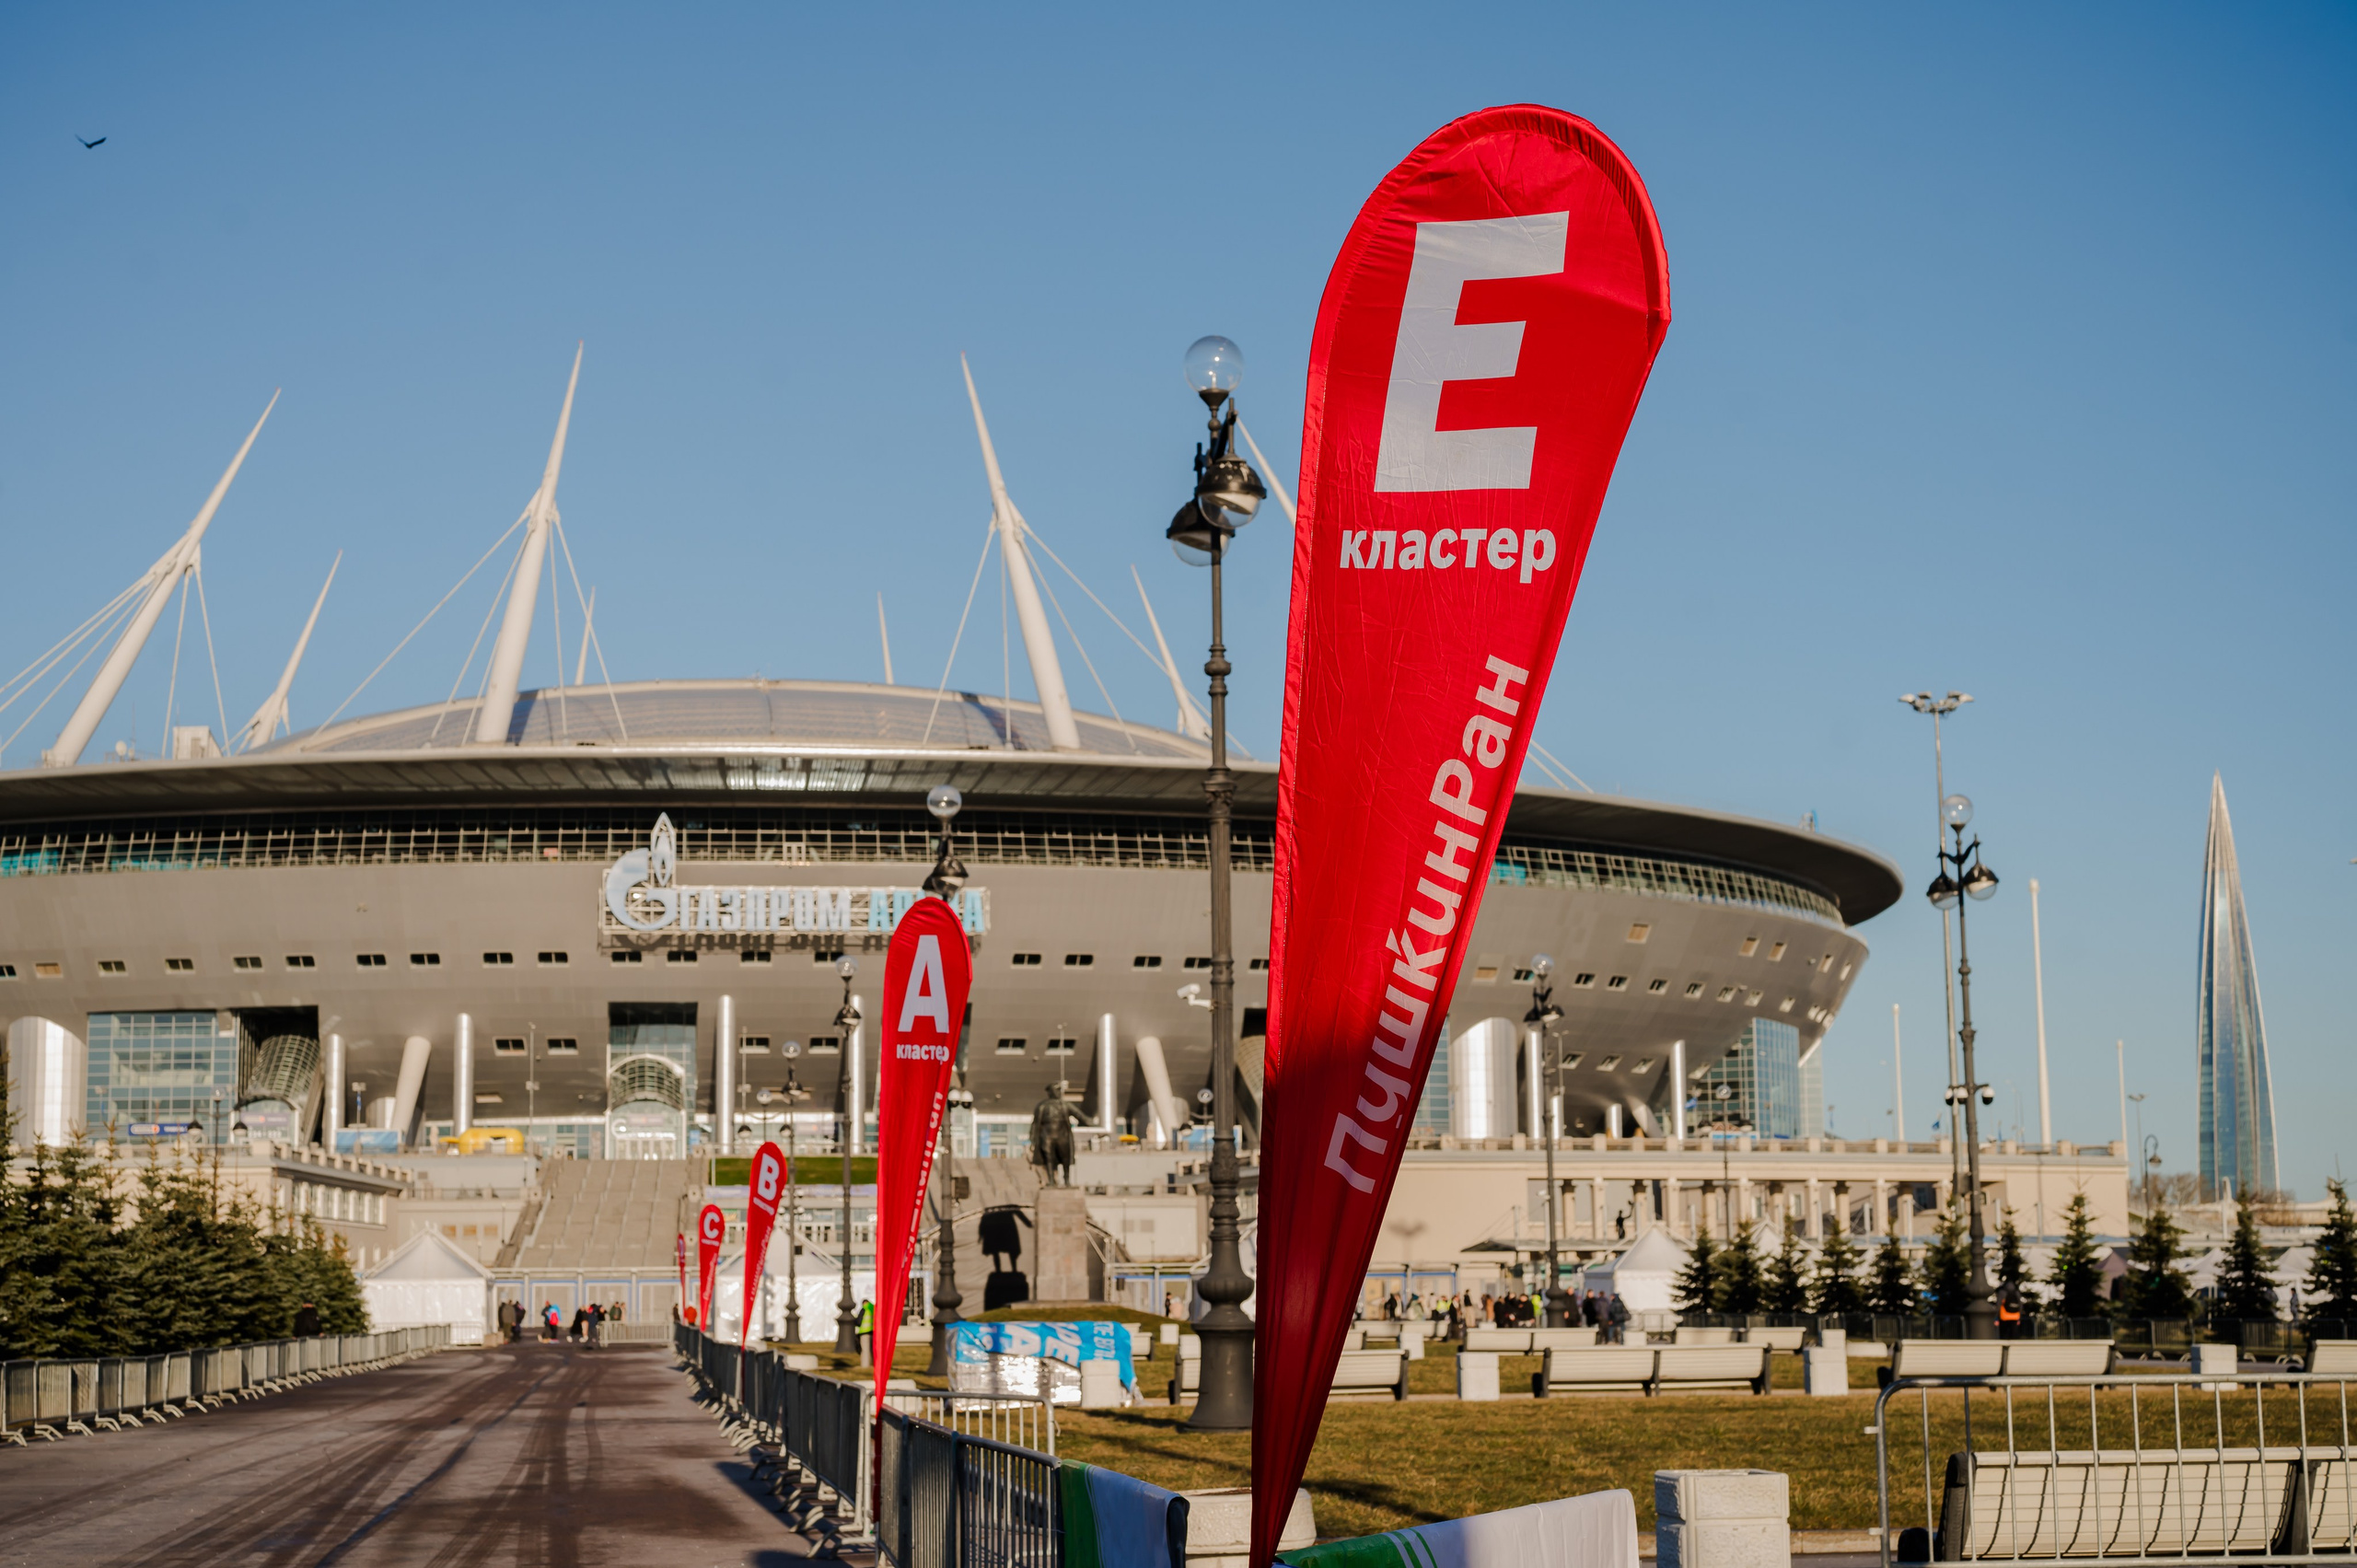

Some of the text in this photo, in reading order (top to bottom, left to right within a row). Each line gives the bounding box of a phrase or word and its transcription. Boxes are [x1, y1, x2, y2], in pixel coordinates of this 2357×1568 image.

[1374, 211, 1570, 493] E
[1339, 527, 1557, 585] кластер
[679, 889, 985, 933] ГАЗПРОМ АРА
[898, 935, 950, 1033] A
[896, 1043, 950, 1065] кластер
[758, 1153, 780, 1201] B
[703, 1212, 720, 1238] C
